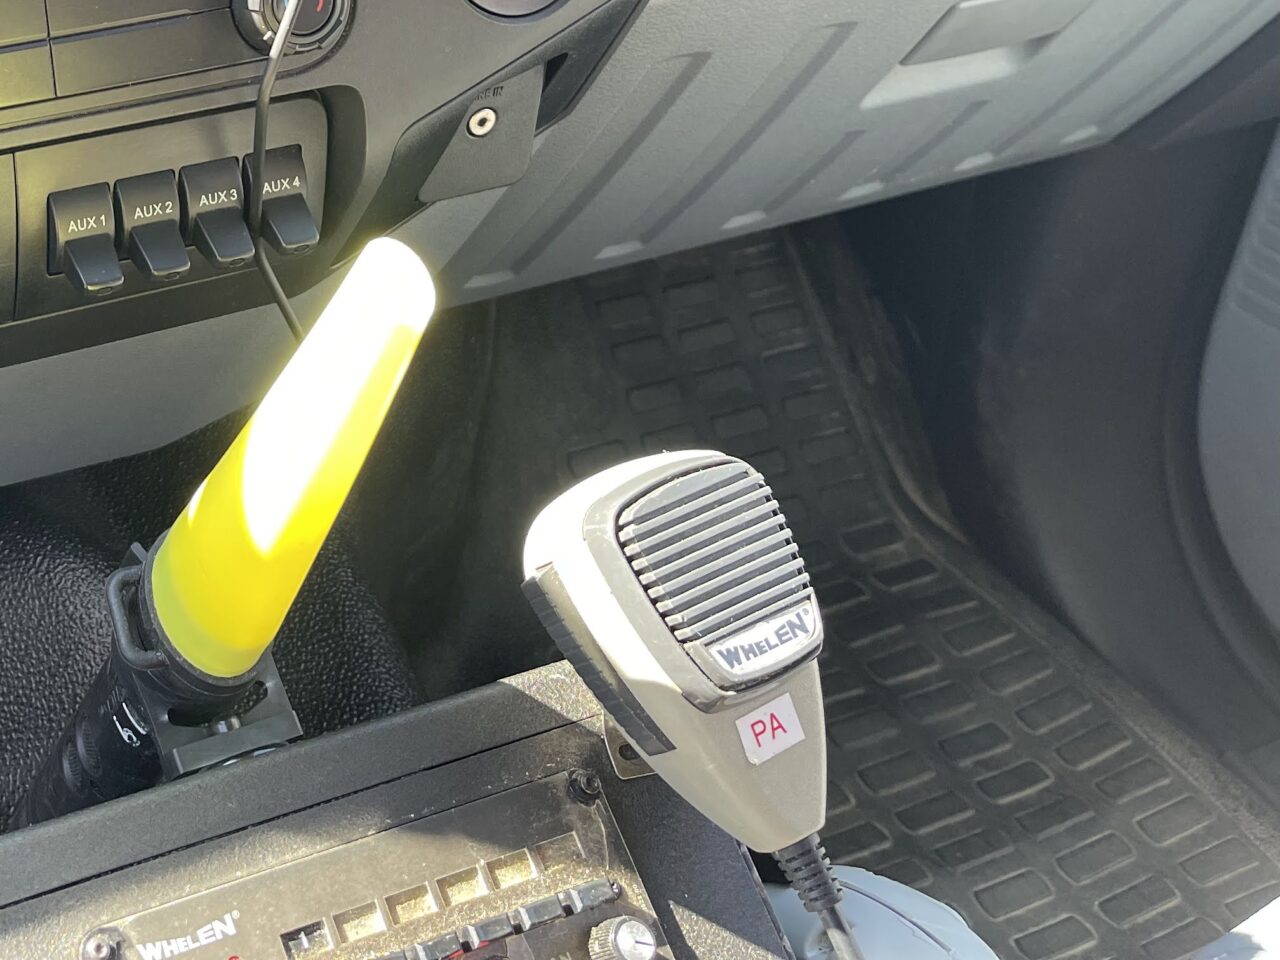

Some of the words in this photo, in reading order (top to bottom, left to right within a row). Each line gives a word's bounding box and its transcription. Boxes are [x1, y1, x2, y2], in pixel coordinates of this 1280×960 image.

[262, 179, 291, 194] AUX
[291, 176, 301, 189] 4
[199, 191, 228, 207] AUX
[229, 189, 238, 201] 3
[134, 204, 163, 220] AUX
[164, 201, 174, 214] 2
[68, 216, 98, 233] AUX
[99, 217, 107, 228] 1
[750, 712, 788, 748] PA
